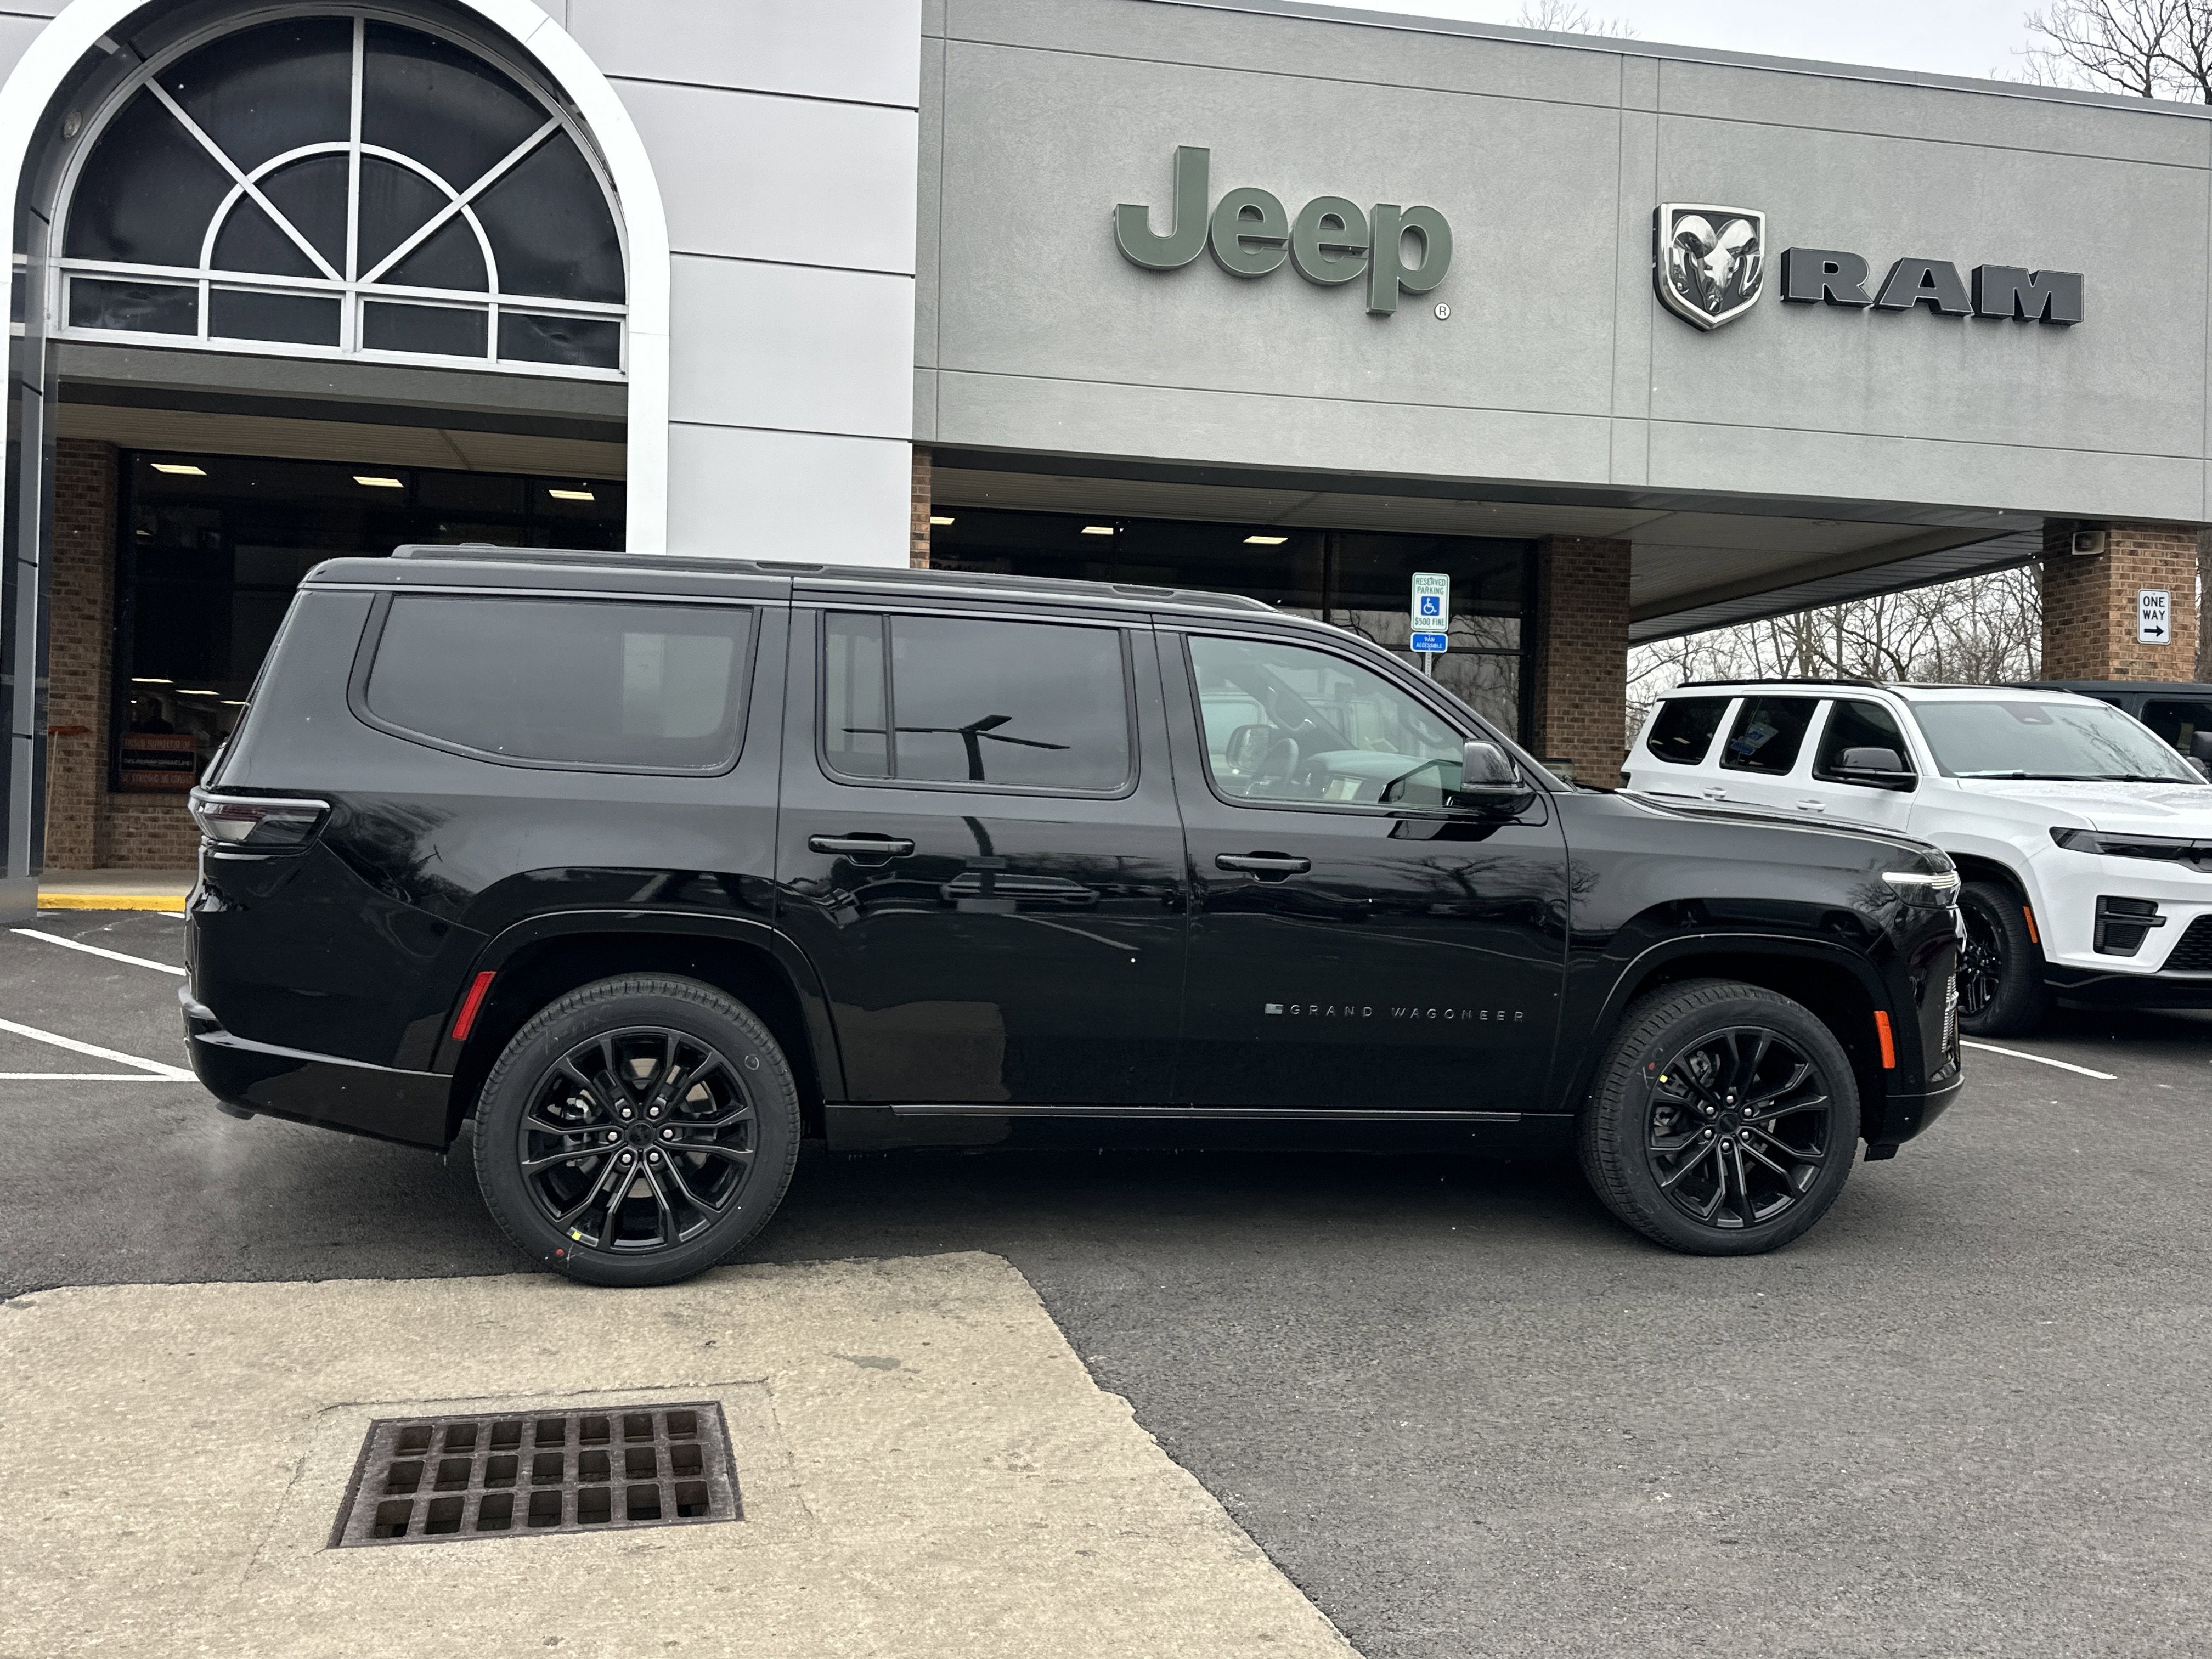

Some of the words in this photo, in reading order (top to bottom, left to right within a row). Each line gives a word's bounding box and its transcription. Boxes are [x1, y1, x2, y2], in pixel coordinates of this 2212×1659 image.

[1113, 145, 1453, 315] Jeep
[1780, 247, 2084, 326] RAM
[1415, 577, 1446, 586] RESERVED
[1417, 586, 1444, 595] PARKING
[2143, 596, 2165, 607] ONE
[2143, 609, 2165, 620] WAY
[1415, 617, 1430, 625] $500
[1432, 618, 1445, 626] FINE
[1290, 1004, 1372, 1017] GRAND
[1392, 1007, 1523, 1022] WAGONEER
